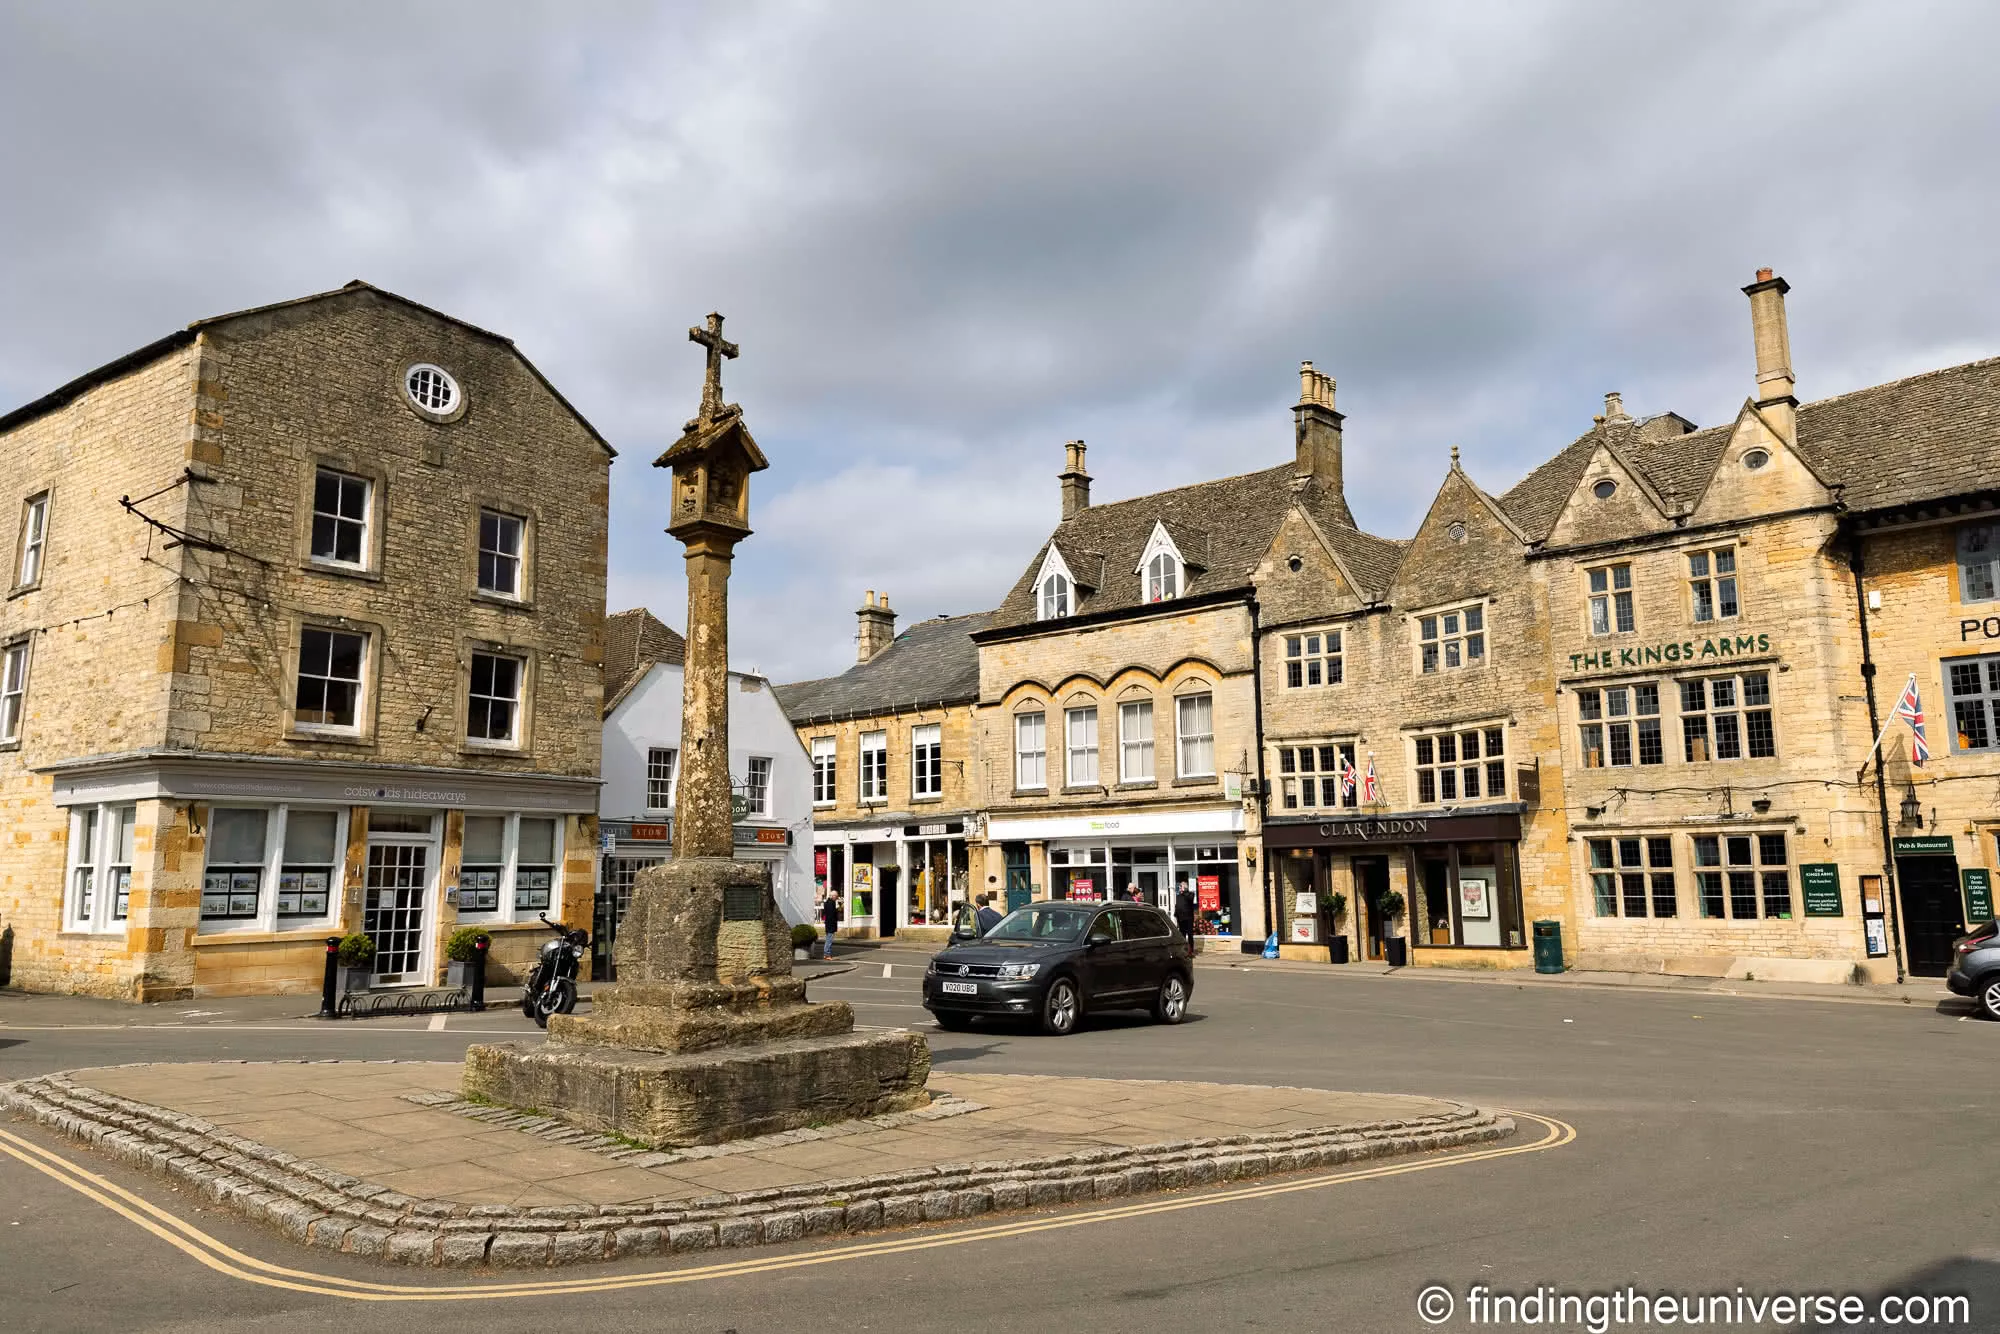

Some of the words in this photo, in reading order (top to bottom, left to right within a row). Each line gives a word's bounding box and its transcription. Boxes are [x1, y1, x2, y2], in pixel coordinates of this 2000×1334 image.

[1960, 617, 2000, 642] PO
[1569, 649, 1613, 672] THE
[1620, 641, 1694, 666] KINGS
[1701, 633, 1769, 658] ARMS
[404, 788, 467, 803] hideaways
[636, 828, 662, 837] STOW
[1320, 819, 1427, 841] CLARENDON
